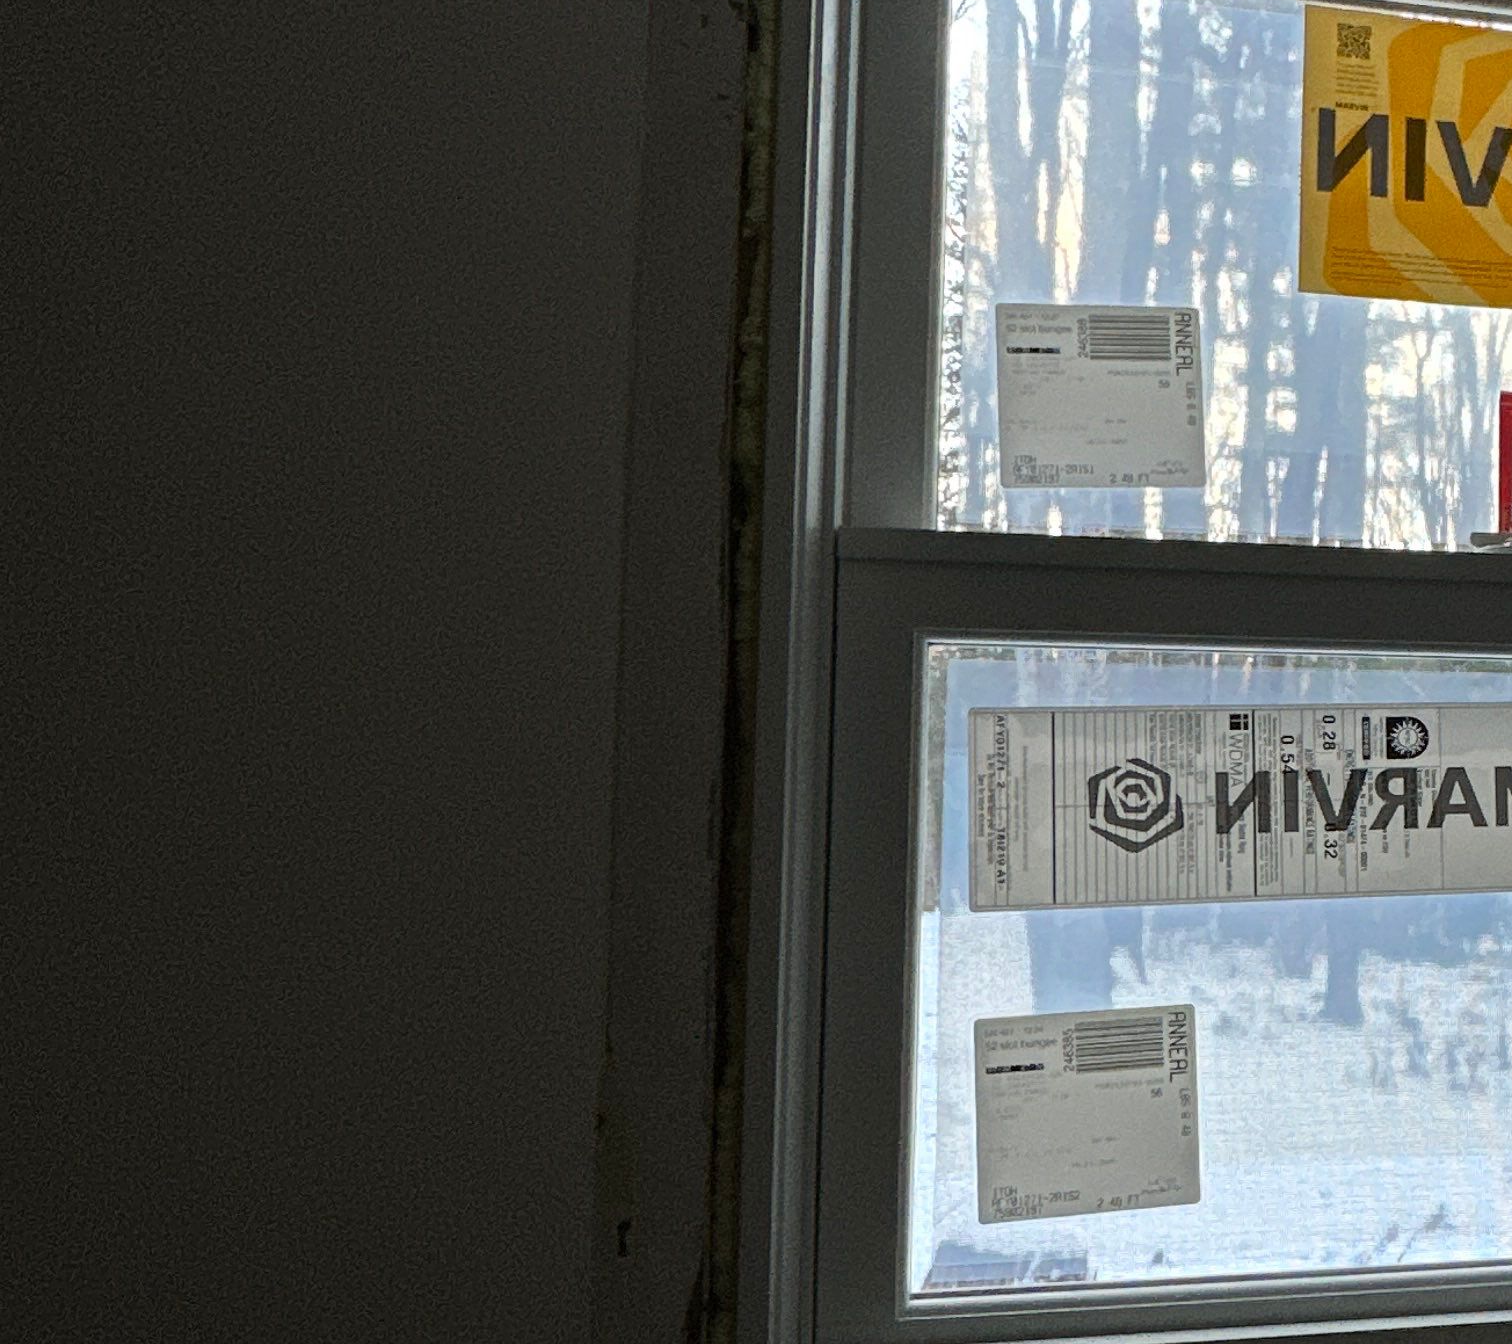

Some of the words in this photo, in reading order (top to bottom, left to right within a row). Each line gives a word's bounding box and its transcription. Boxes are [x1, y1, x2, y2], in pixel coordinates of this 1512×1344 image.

[1322, 714, 1337, 751] 0.28
[1228, 733, 1244, 788] WDMA
[1168, 1011, 1189, 1084] ANNEAL
